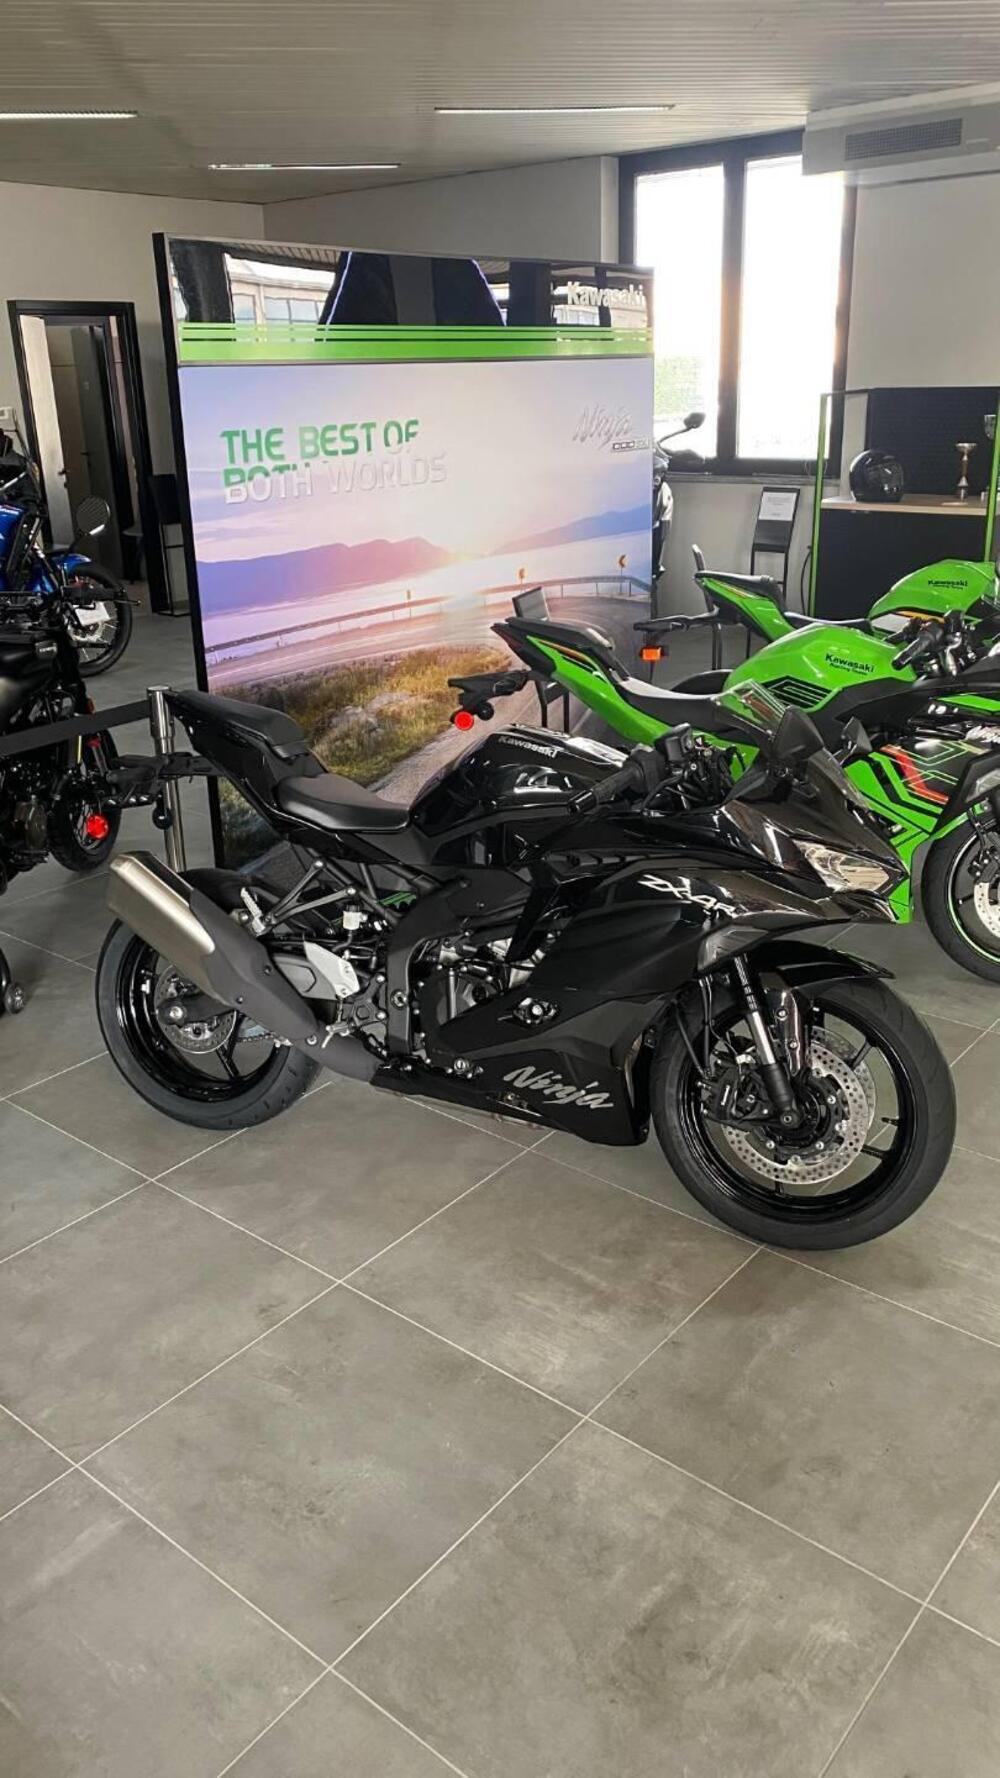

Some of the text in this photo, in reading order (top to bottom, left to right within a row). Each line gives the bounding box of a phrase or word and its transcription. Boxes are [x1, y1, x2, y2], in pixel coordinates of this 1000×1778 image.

[567, 281, 644, 307] Kawasaki
[220, 419, 419, 464] THE BEST OF
[223, 452, 448, 505] BOTH WORLDS
[825, 652, 875, 673] Kawasaki
[499, 735, 559, 758] Kawasaki
[638, 874, 739, 919] ZX-4R
[503, 1066, 614, 1109] Ninja
